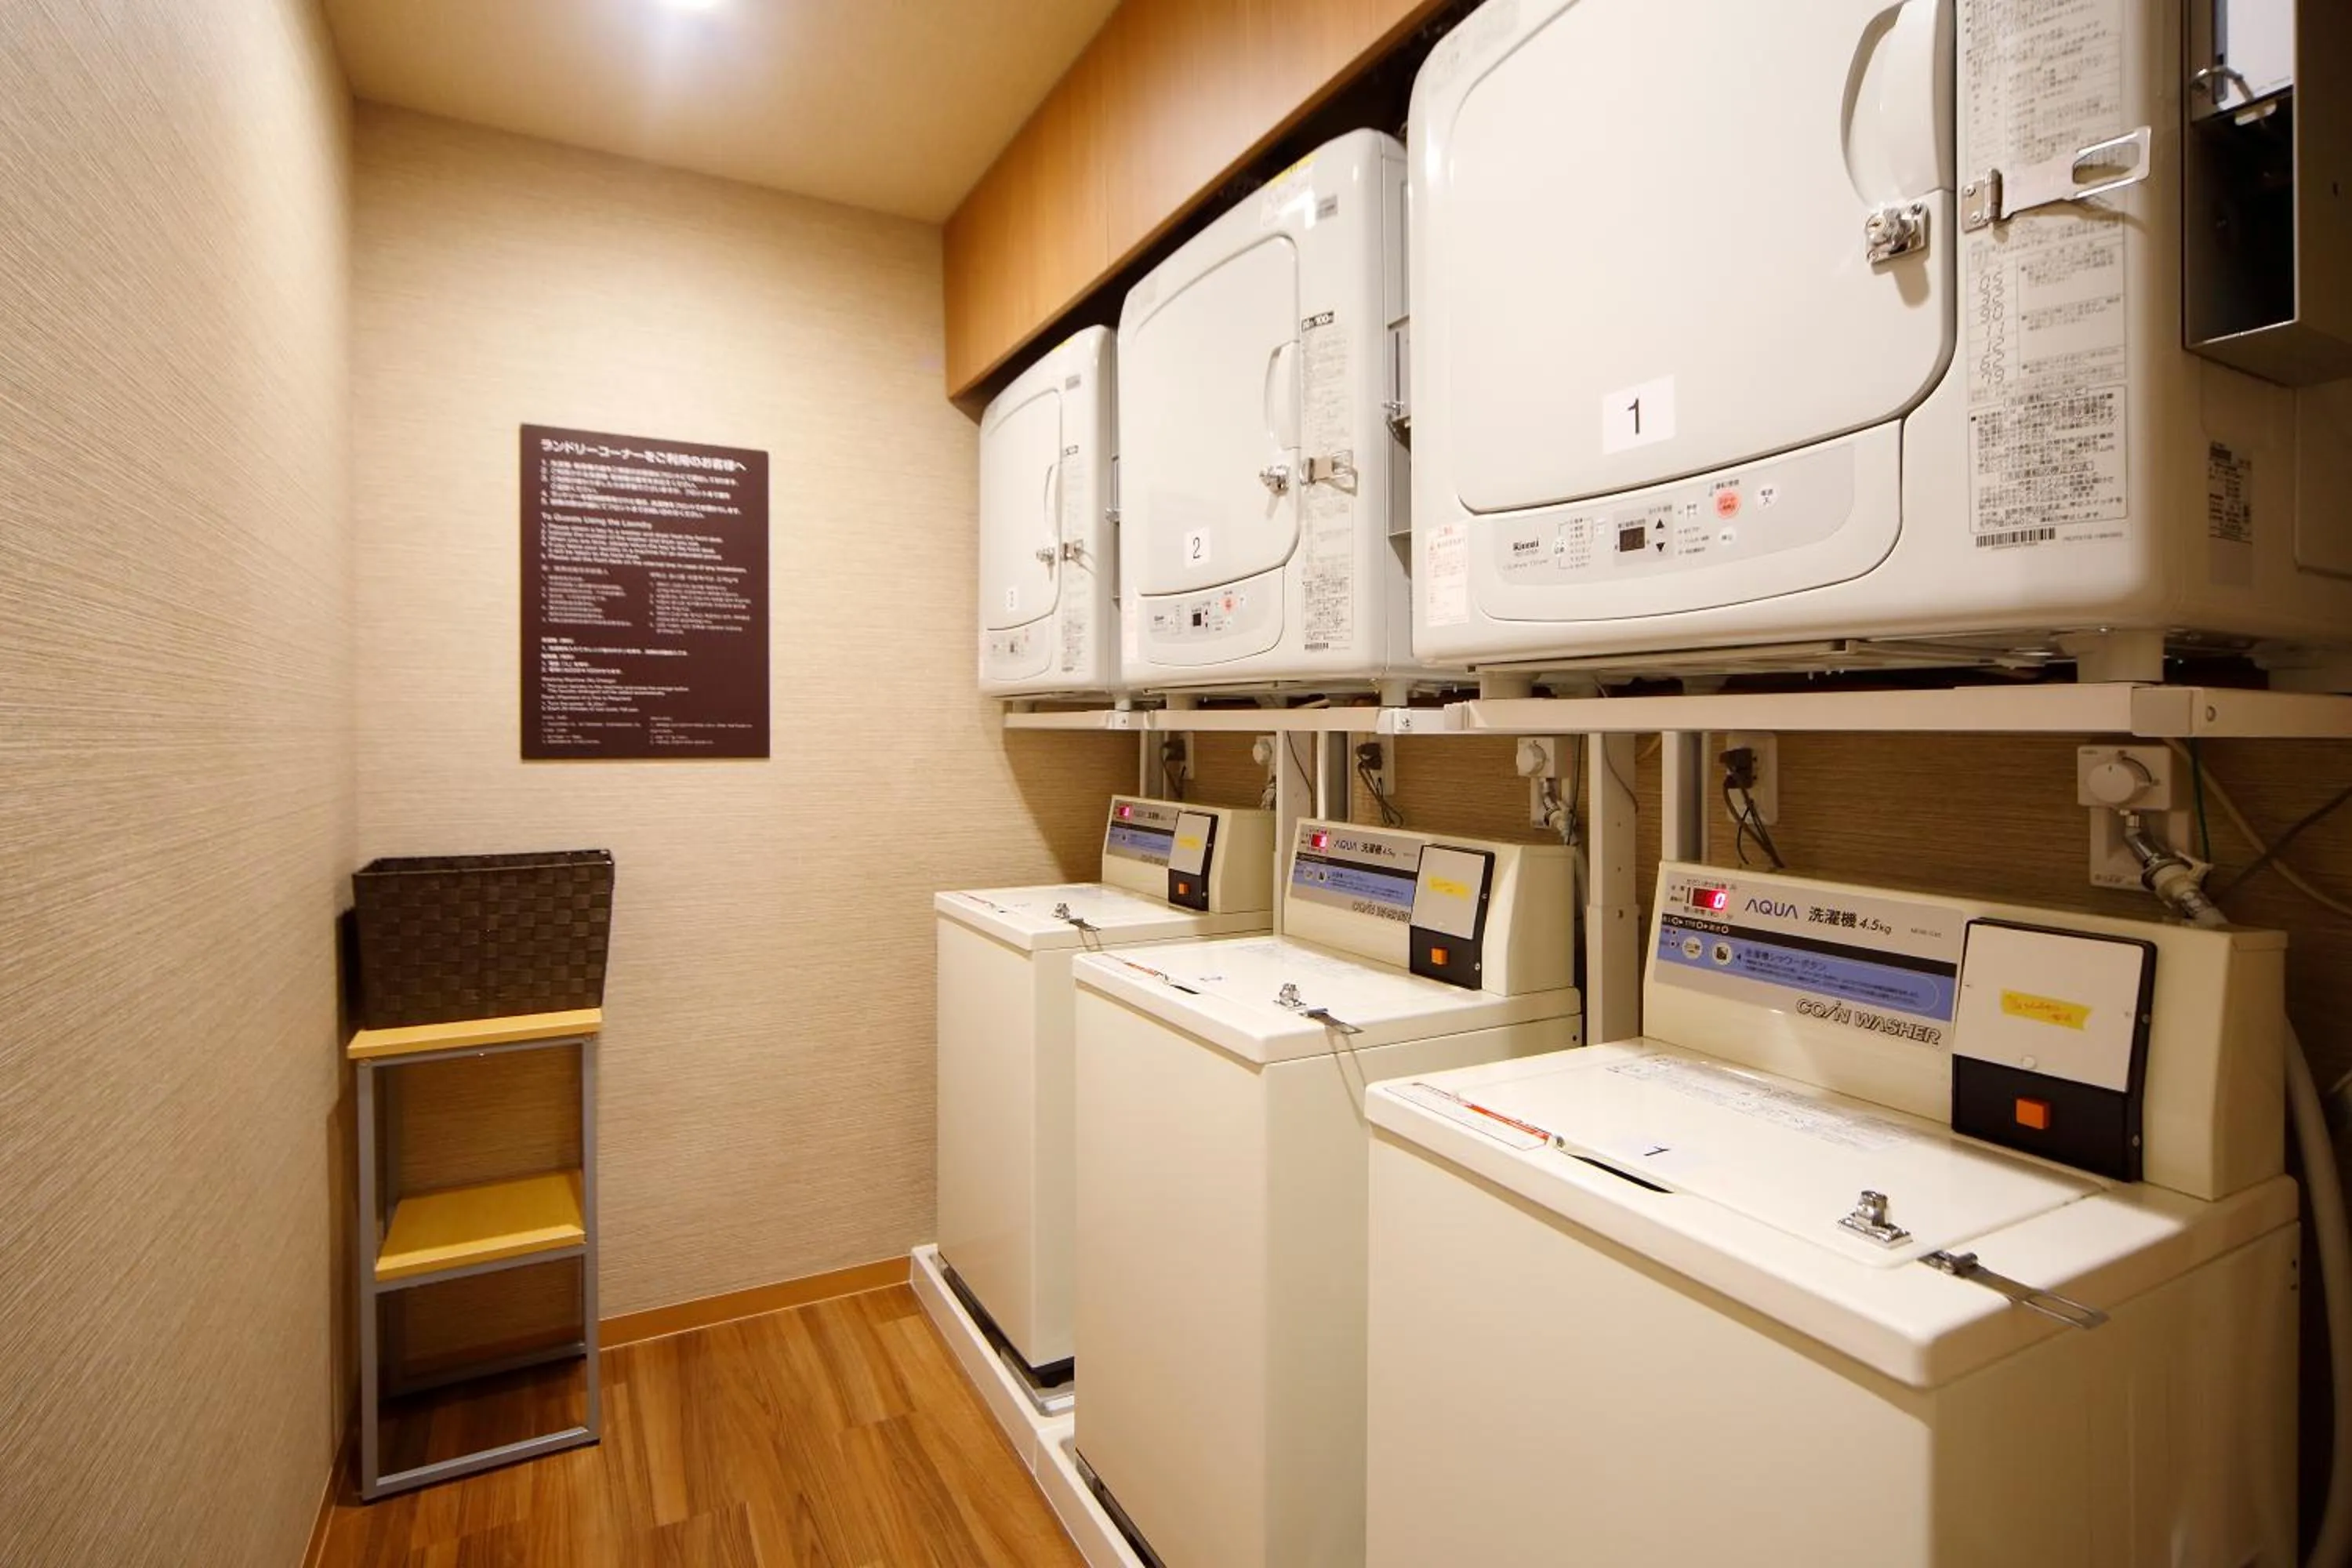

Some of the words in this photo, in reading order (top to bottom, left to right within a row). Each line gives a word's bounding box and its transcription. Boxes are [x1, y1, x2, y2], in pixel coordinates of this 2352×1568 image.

[1627, 396, 1641, 435] 1
[1192, 536, 1202, 560] 2
[1712, 891, 1726, 909] 0
[1744, 898, 1798, 920] AQUA
[1808, 906, 1858, 929] 洗濯機
[1859, 917, 1892, 935] 4.5kg
[1854, 1011, 1942, 1045] WASHER
